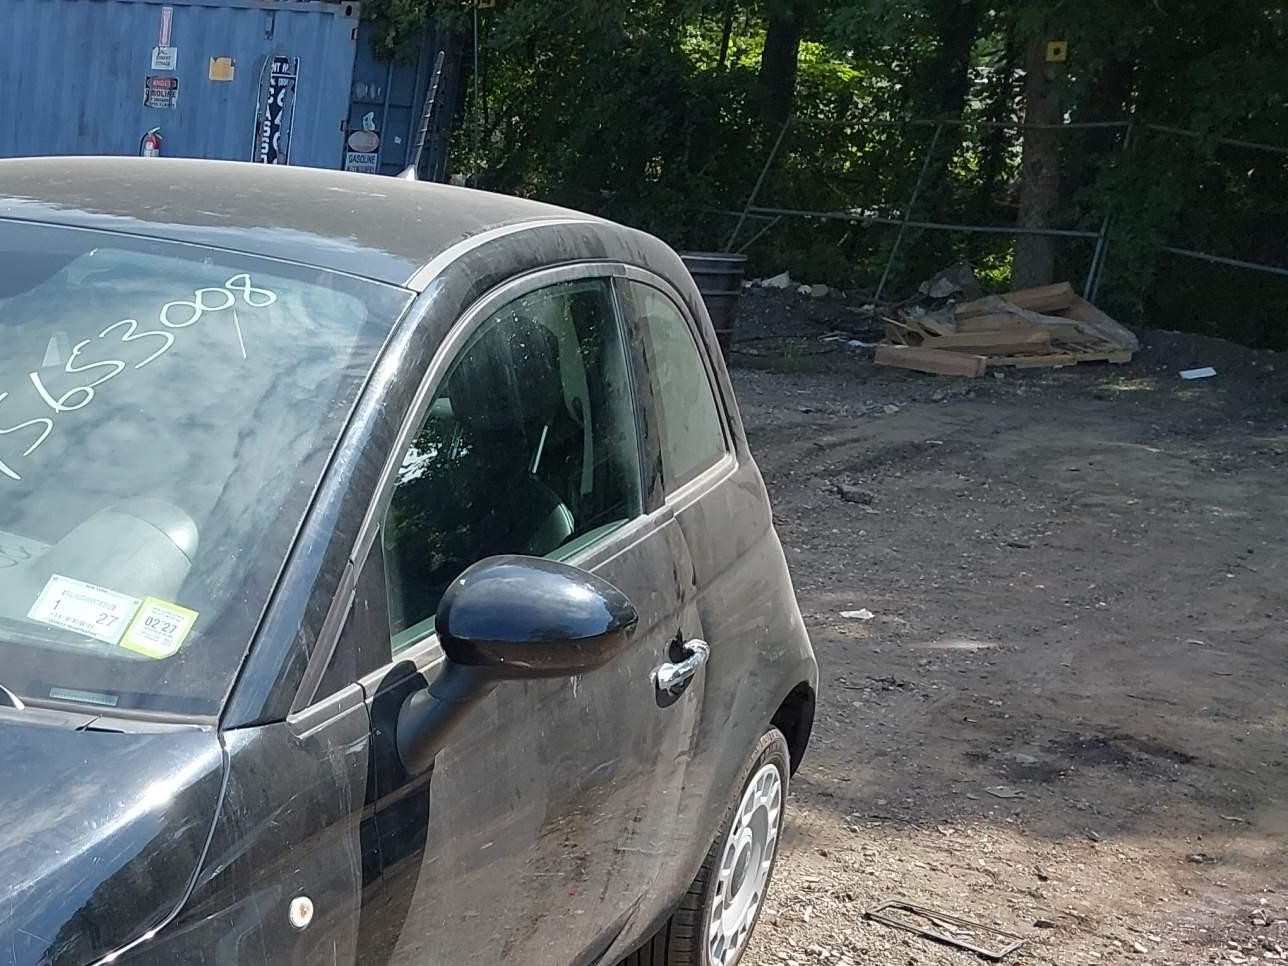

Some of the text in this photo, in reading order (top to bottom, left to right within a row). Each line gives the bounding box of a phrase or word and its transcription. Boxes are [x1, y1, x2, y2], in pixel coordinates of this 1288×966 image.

[348, 153, 376, 165] GASOLINE
[52, 599, 61, 611] 1
[95, 612, 120, 628] 27
